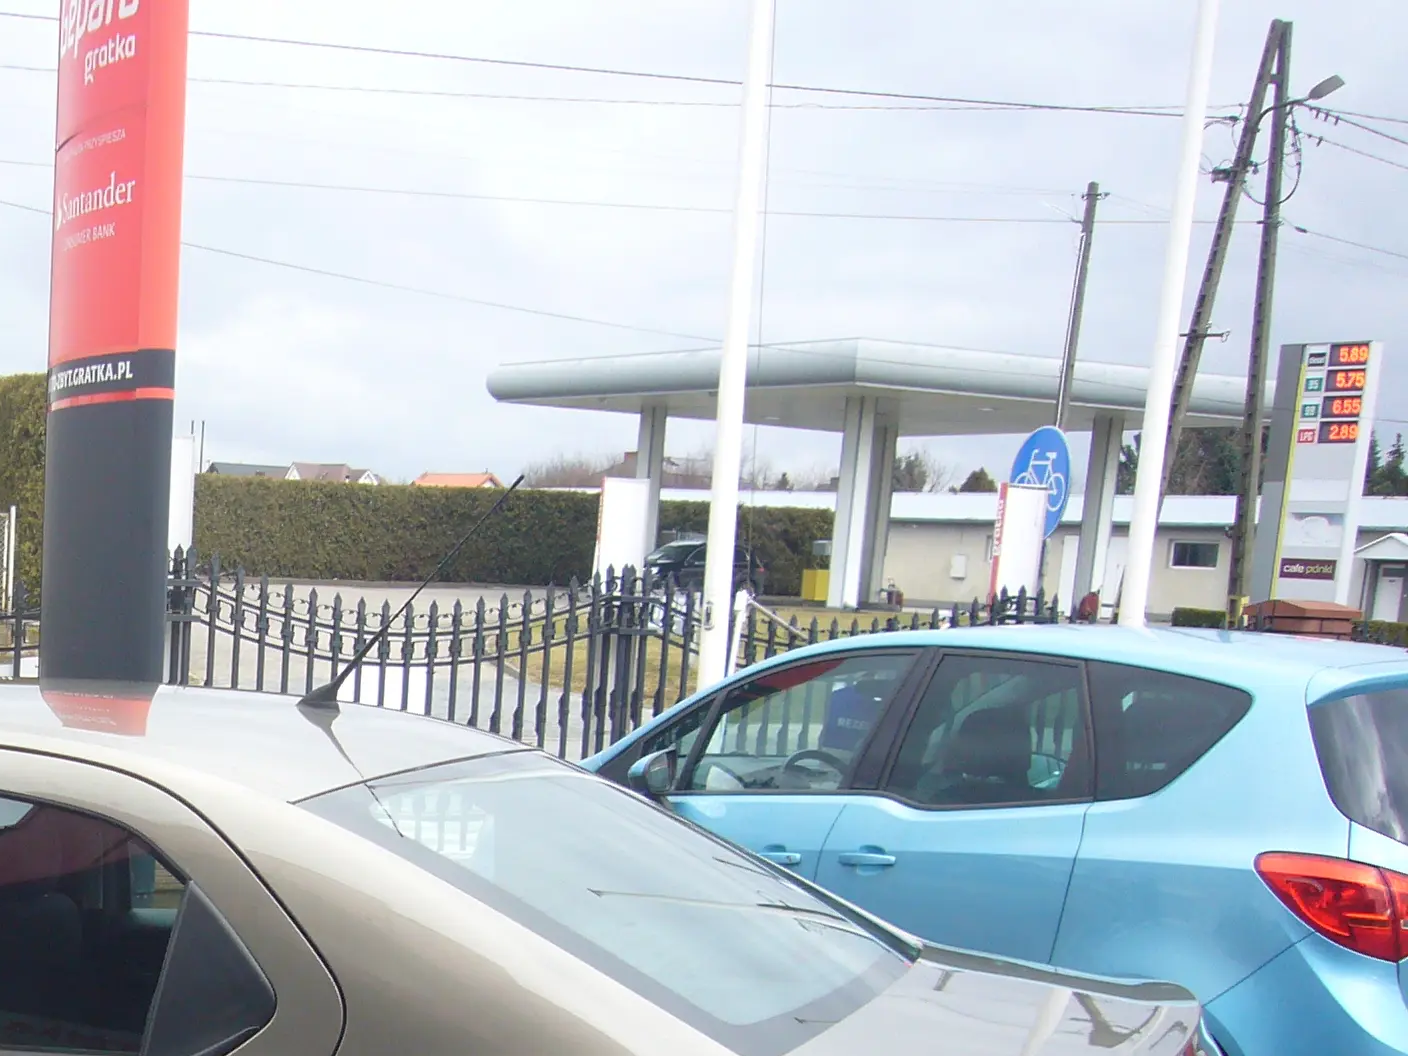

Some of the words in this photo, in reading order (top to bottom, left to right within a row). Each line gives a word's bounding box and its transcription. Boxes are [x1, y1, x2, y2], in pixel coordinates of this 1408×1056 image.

[84, 32, 137, 86] gratka
[62, 170, 136, 225] Santander
[92, 222, 116, 241] BANK
[1339, 346, 1369, 363] 5.89
[1335, 371, 1365, 388] 5.75
[1332, 398, 1361, 415] 6.55
[1299, 431, 1314, 441] LPG
[1328, 424, 1359, 440] 2.89
